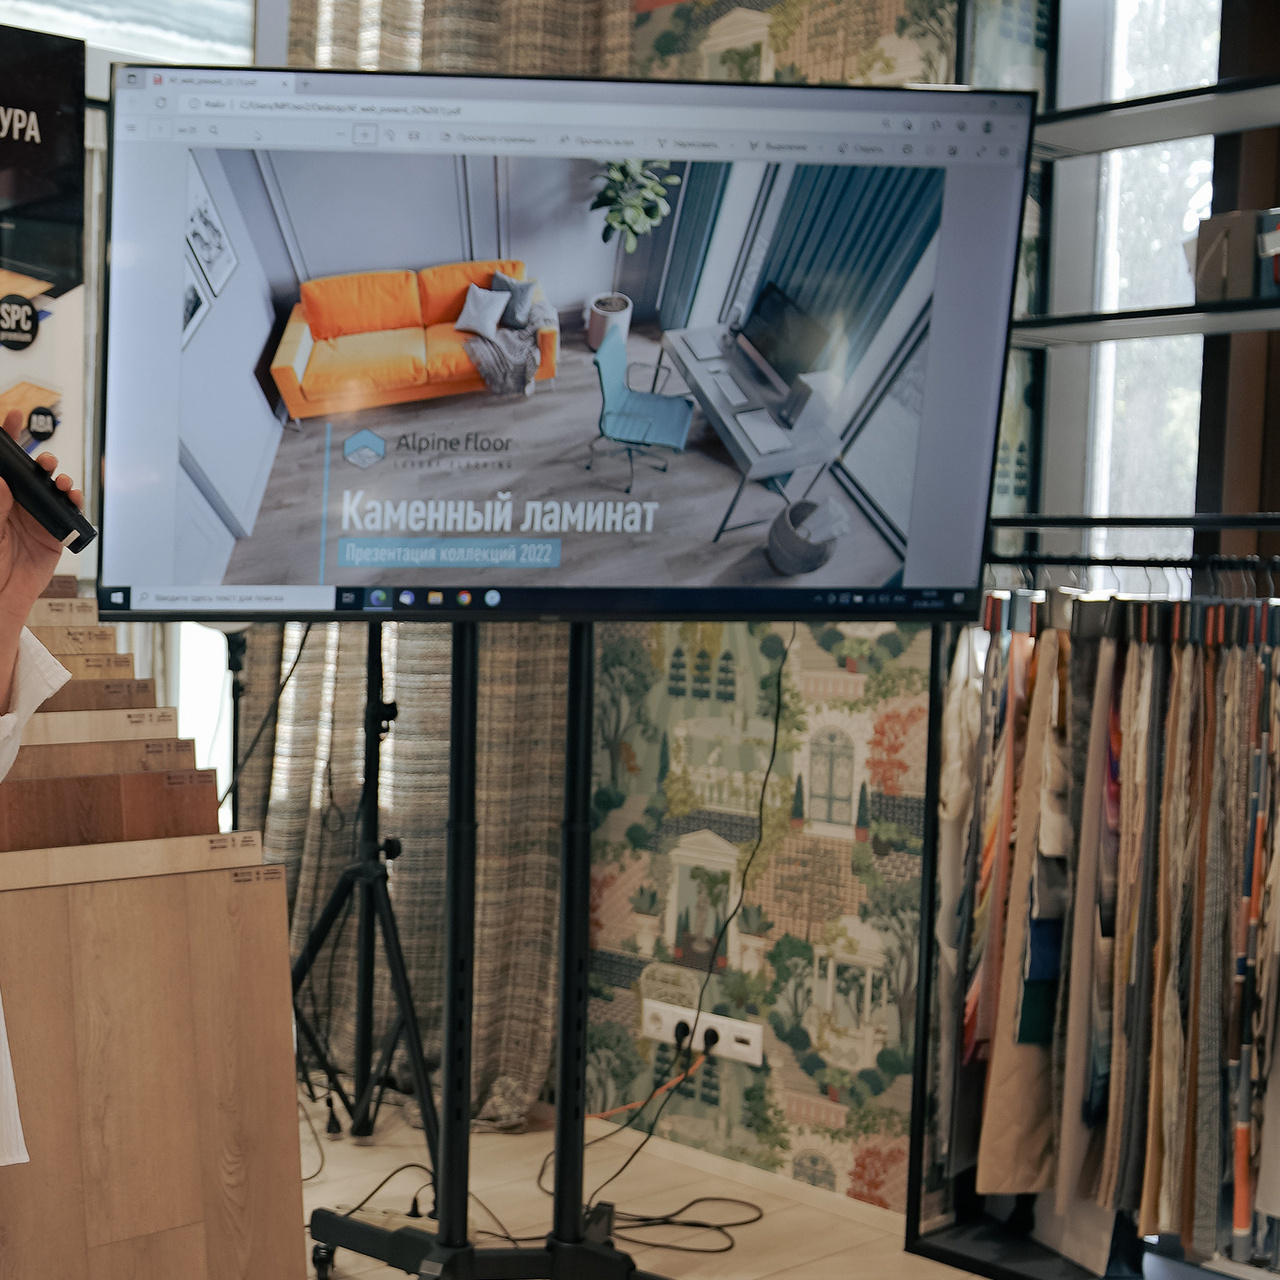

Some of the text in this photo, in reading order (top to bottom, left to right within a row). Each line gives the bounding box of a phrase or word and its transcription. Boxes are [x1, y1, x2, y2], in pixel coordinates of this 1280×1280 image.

[0, 303, 32, 331] SPC
[396, 432, 460, 454] Alpine
[342, 489, 659, 533] Каменный ламинат
[346, 543, 552, 565] Презентация коллекций 2022
